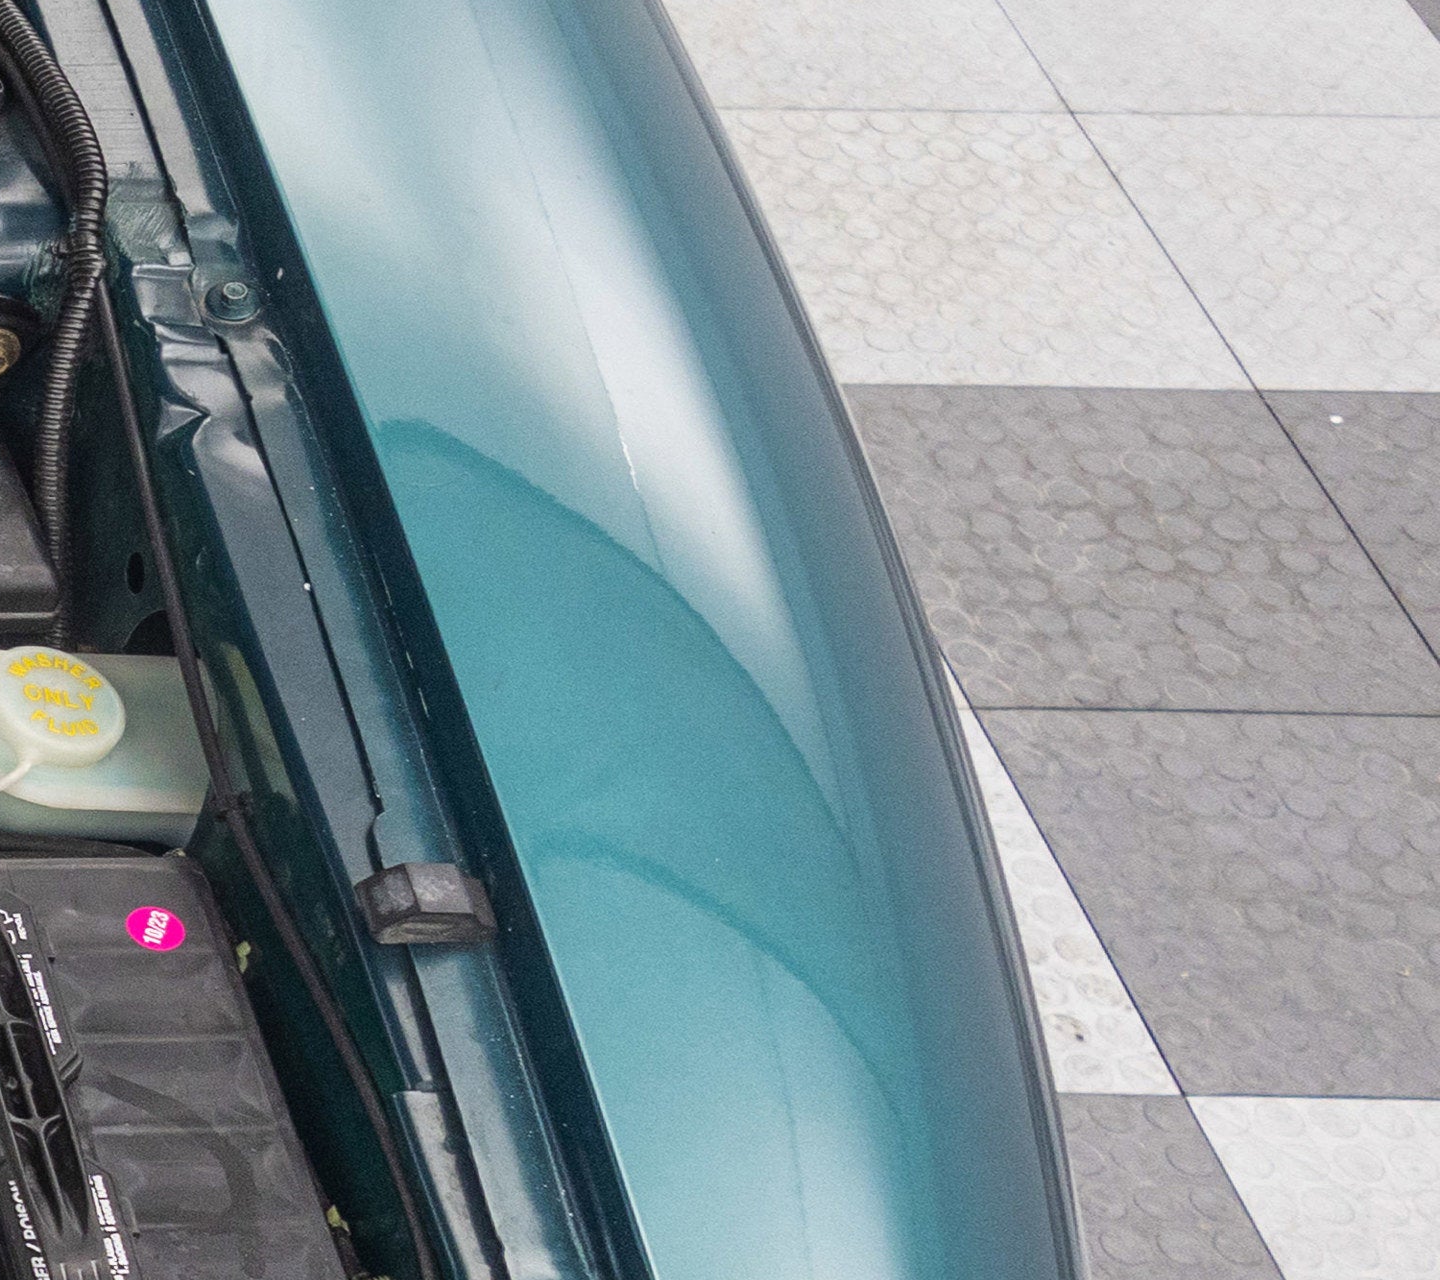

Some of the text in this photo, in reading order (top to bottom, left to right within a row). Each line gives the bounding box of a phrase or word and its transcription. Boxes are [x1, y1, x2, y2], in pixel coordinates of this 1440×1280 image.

[8, 652, 103, 690] WASHER
[23, 683, 95, 712] ONLY
[30, 709, 100, 737] FLUID
[143, 910, 169, 945] 10/23
